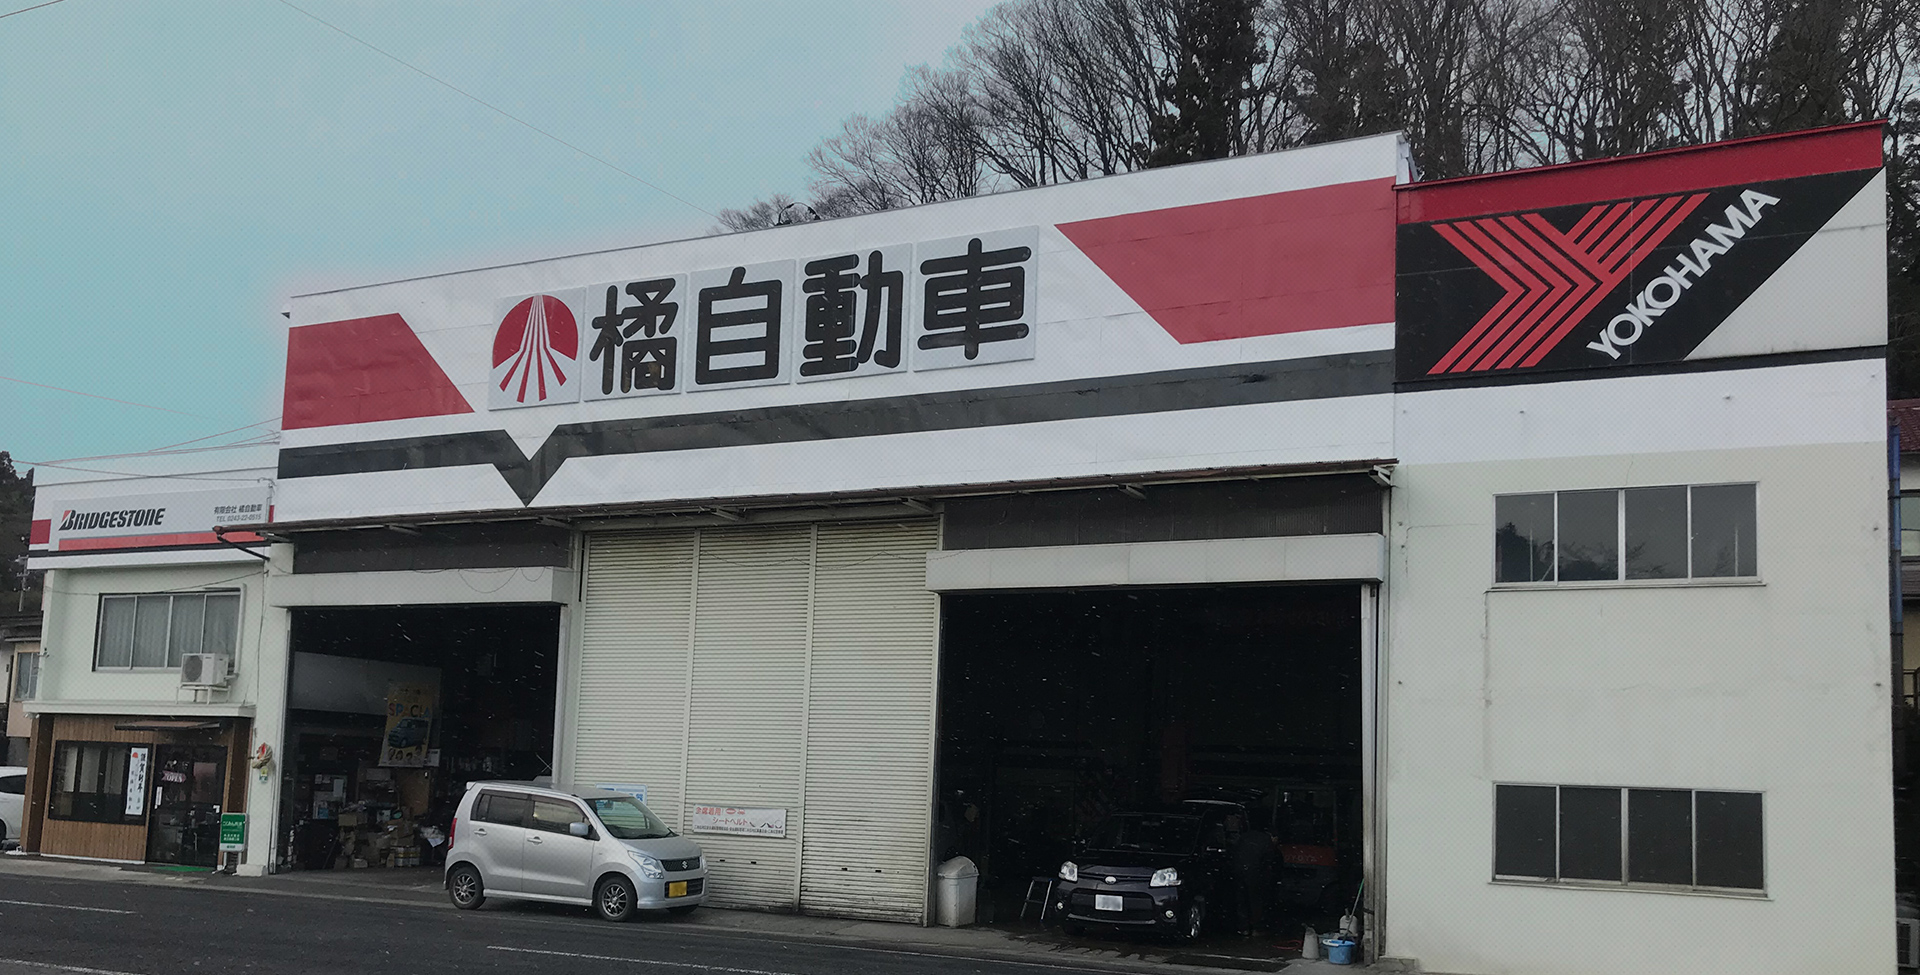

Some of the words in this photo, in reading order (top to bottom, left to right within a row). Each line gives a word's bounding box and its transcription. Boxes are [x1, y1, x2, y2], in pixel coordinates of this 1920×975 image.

[589, 237, 1033, 395] 橘自動車
[1586, 189, 1781, 361] YOKOHAMA
[58, 507, 166, 531] BRIDGESTONE
